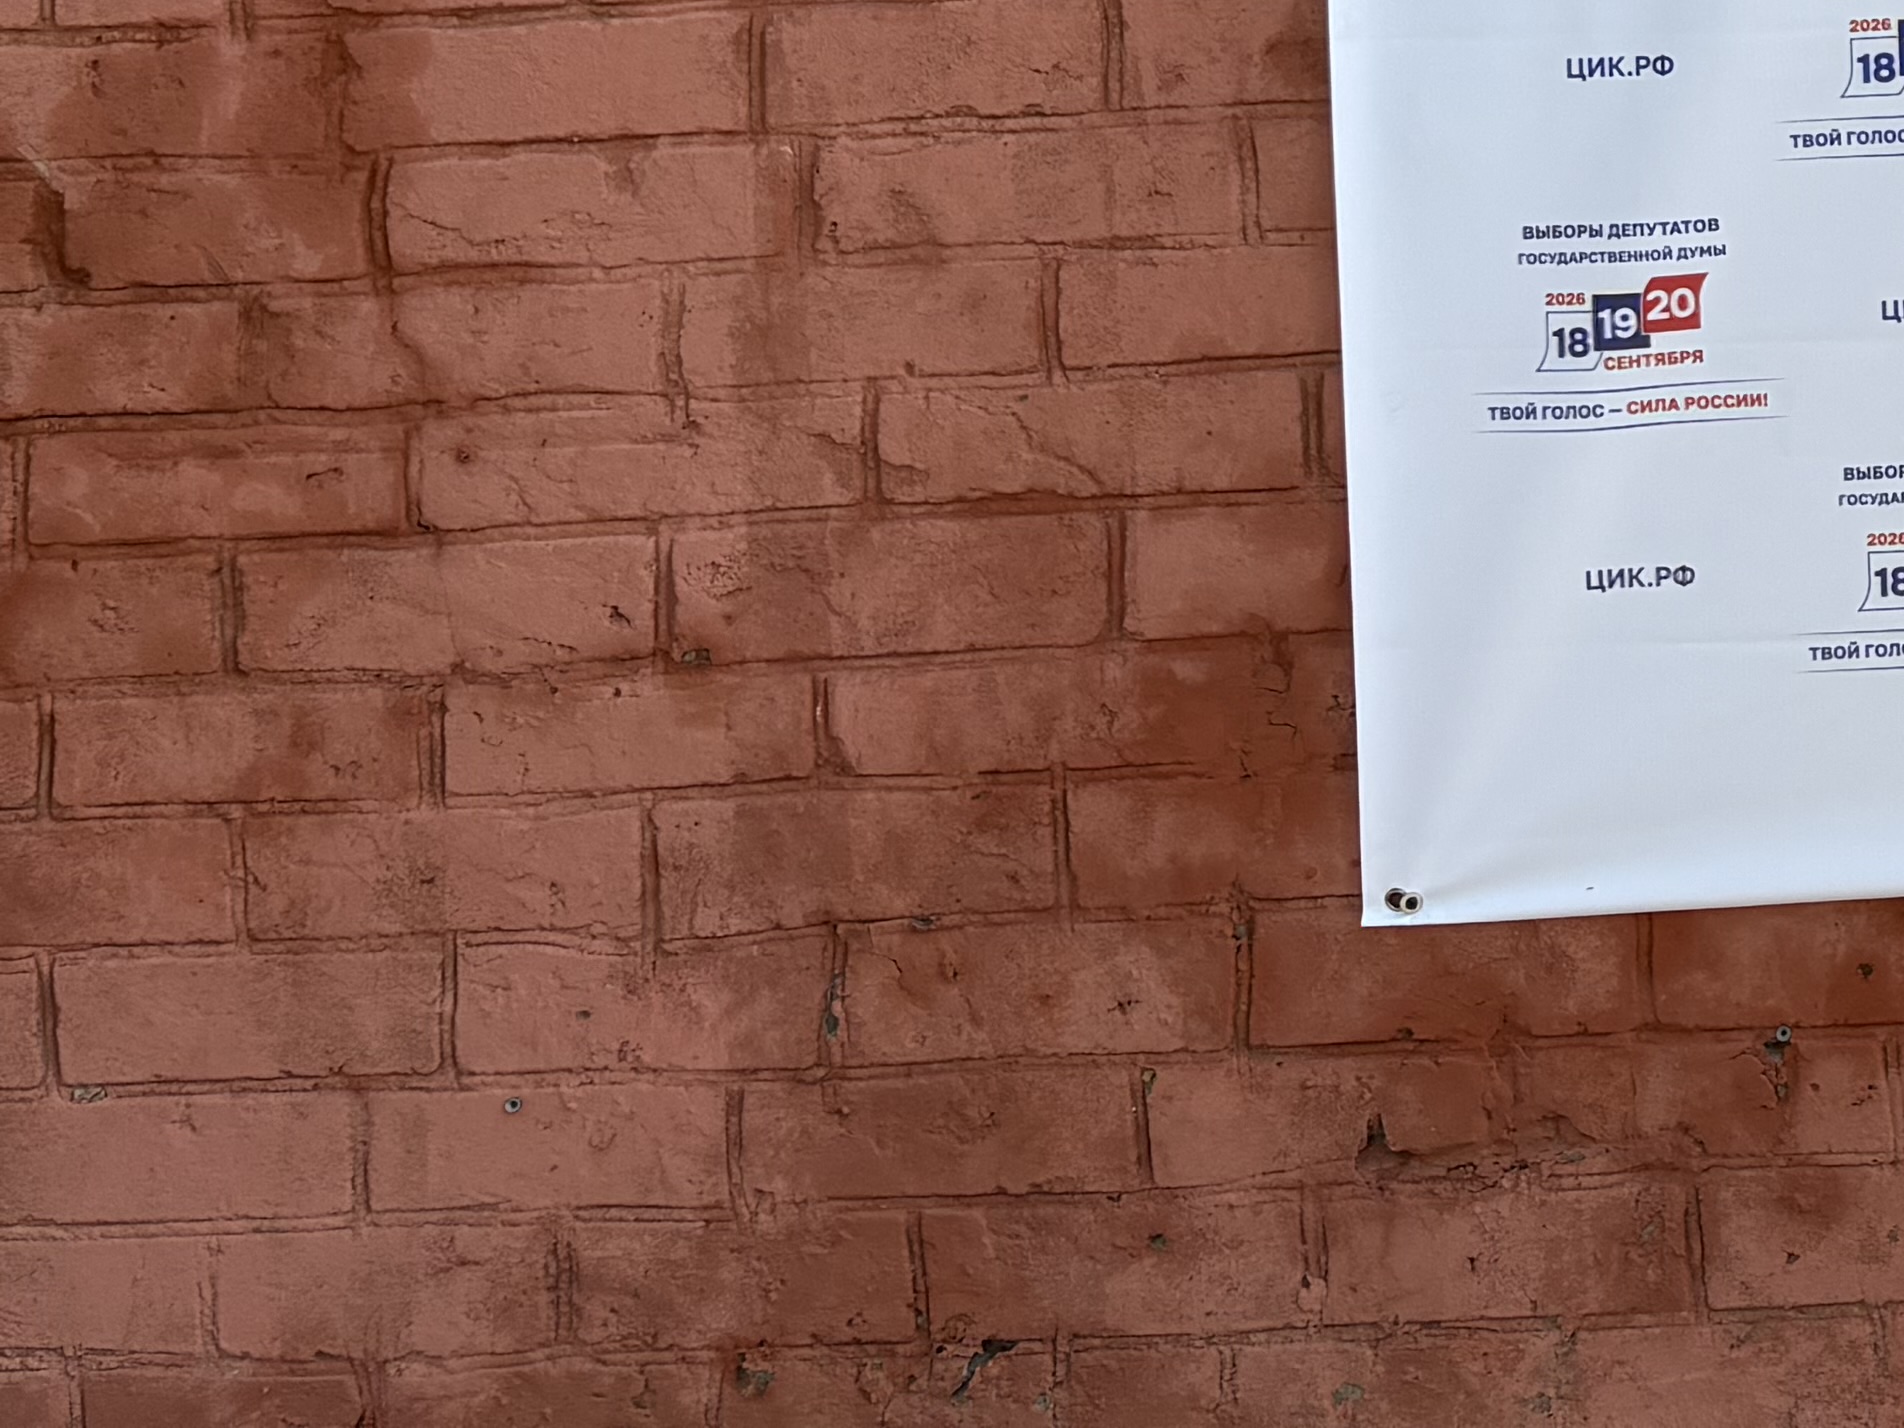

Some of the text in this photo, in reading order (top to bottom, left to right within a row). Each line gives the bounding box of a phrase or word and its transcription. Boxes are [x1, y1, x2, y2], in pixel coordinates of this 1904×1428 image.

[1849, 17, 1892, 33] 2026
[1566, 54, 1675, 82] ЦИК.РФ
[1856, 52, 1896, 84] 18
[1789, 128, 1842, 149] ТВОЙ
[1585, 564, 1696, 593] ЦИК.РФ
